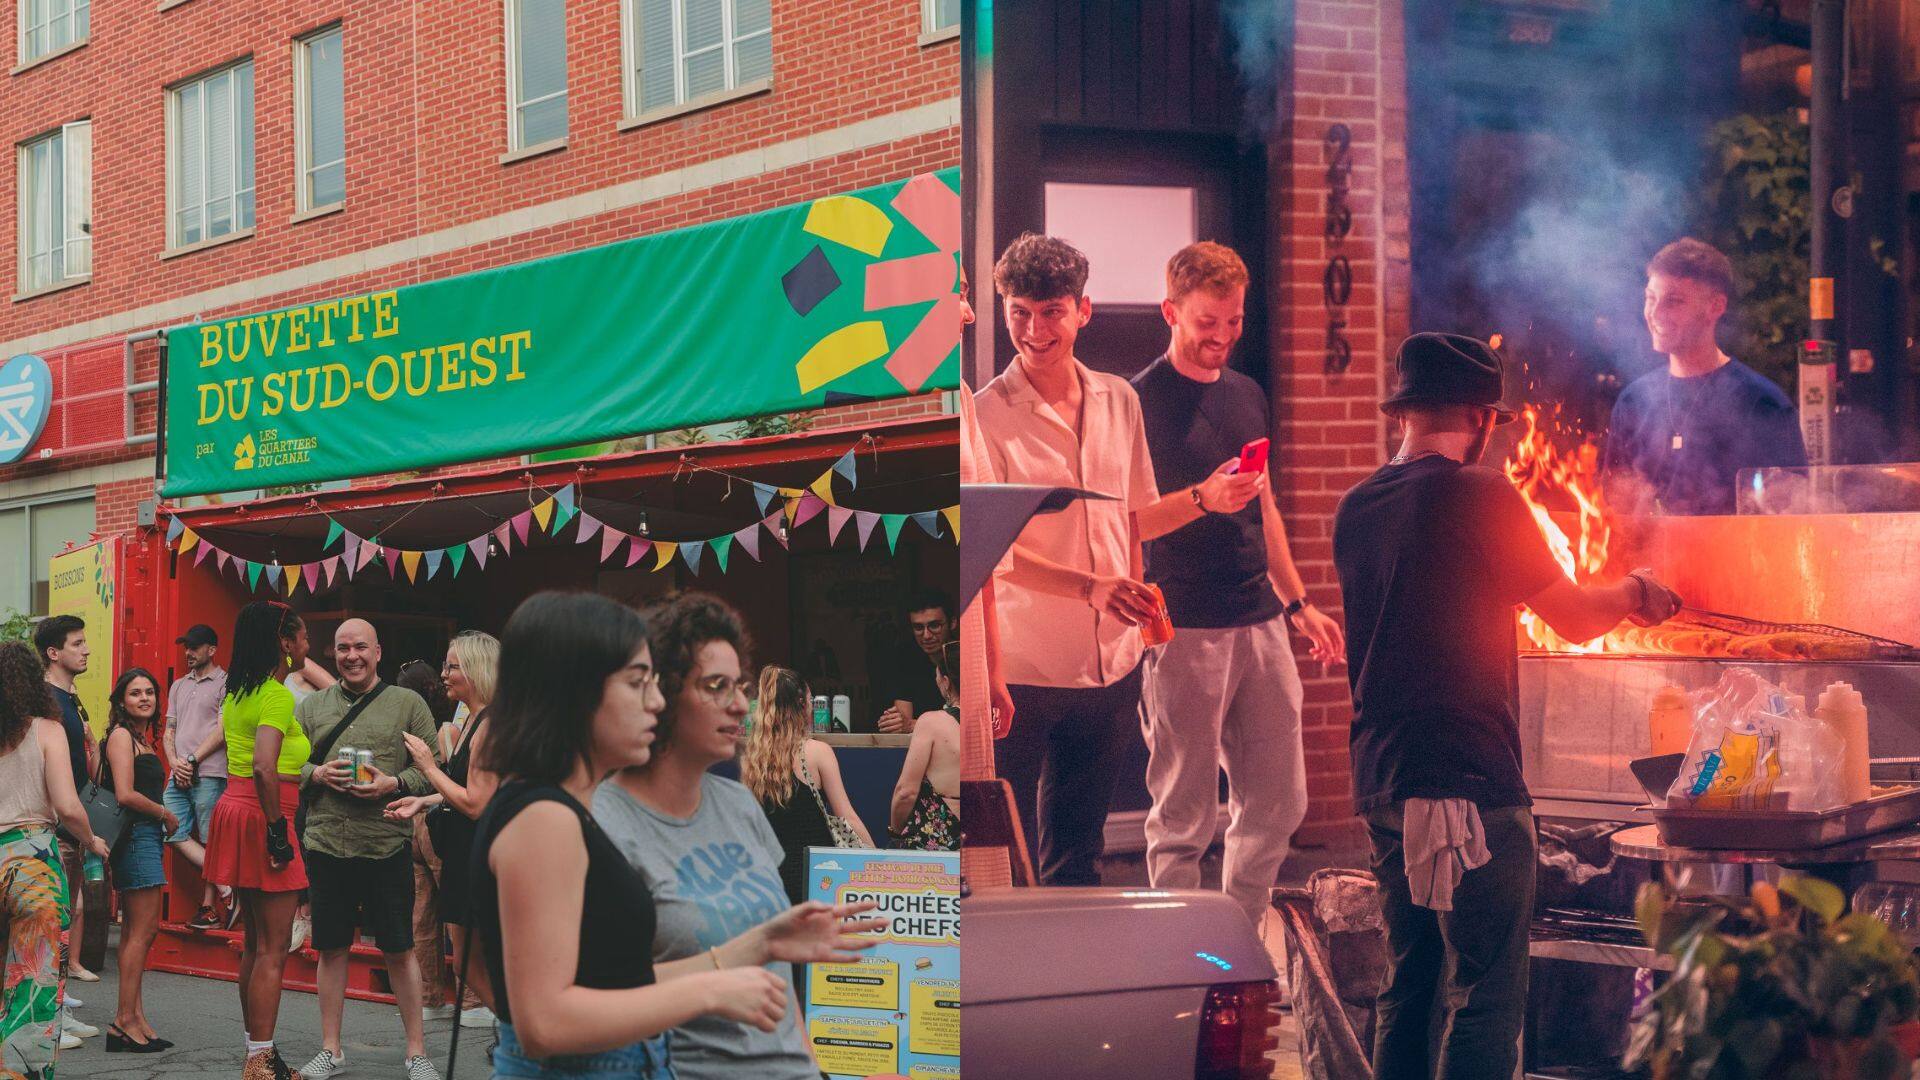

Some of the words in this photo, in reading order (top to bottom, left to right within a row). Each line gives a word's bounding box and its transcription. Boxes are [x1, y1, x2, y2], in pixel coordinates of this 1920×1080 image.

[199, 290, 399, 368] BUVETTE
[197, 377, 254, 425] DU
[262, 330, 531, 416] SUD-OUEST
[259, 429, 278, 442] LES
[196, 442, 214, 459] par
[259, 437, 317, 455] QUARTIERS
[258, 455, 273, 468] DU
[274, 450, 310, 466] CANAL
[54, 566, 85, 590] BOISSONS
